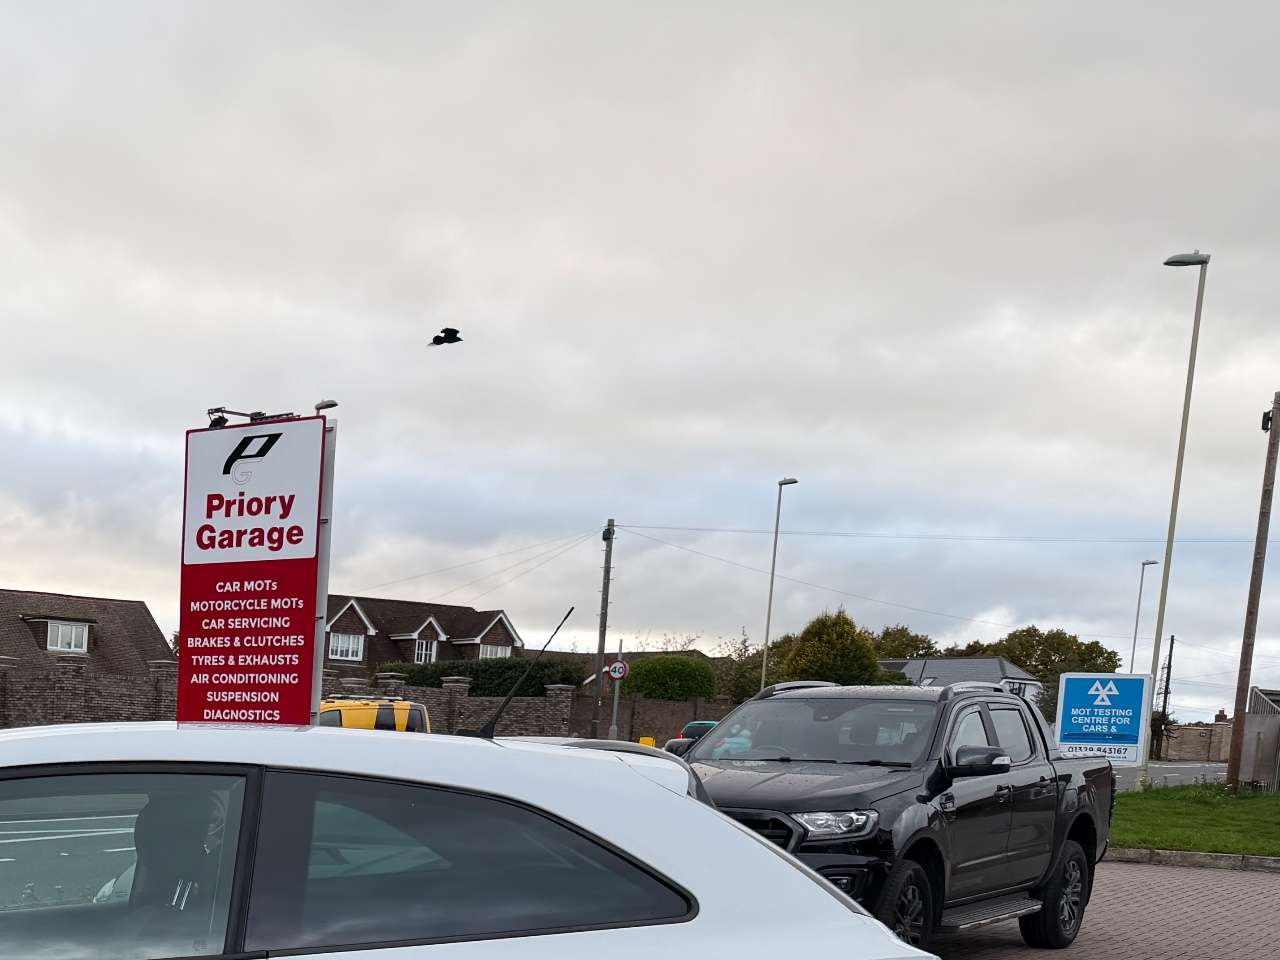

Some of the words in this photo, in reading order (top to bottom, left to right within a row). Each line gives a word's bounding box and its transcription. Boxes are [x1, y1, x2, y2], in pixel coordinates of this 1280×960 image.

[206, 491, 295, 520] Priory
[196, 523, 304, 552] Garage
[216, 581, 241, 593] CAR
[243, 580, 278, 592] MOTs
[190, 599, 268, 612] MOTORCYCLE
[270, 597, 304, 610] MOTs
[201, 618, 225, 630] CAR
[227, 617, 290, 629] SERVICING
[187, 637, 231, 648] BRAKES
[233, 636, 241, 647] &
[243, 635, 305, 647] CLUTCHES
[191, 655, 225, 666] TYRES
[228, 655, 235, 666] &
[238, 654, 299, 666] EXHAUSTS
[611, 666, 624, 675] 40
[190, 673, 209, 684] AIR
[212, 673, 299, 685] CONDITIONING
[206, 691, 279, 703] SUSPENSION
[203, 709, 280, 721] DIAGNOSTICS
[1071, 708, 1092, 716] MOT
[1094, 708, 1133, 717] TESTING
[1071, 716, 1109, 724] CENTRE
[1110, 717, 1131, 725] FOR
[1110, 725, 1117, 733] &
